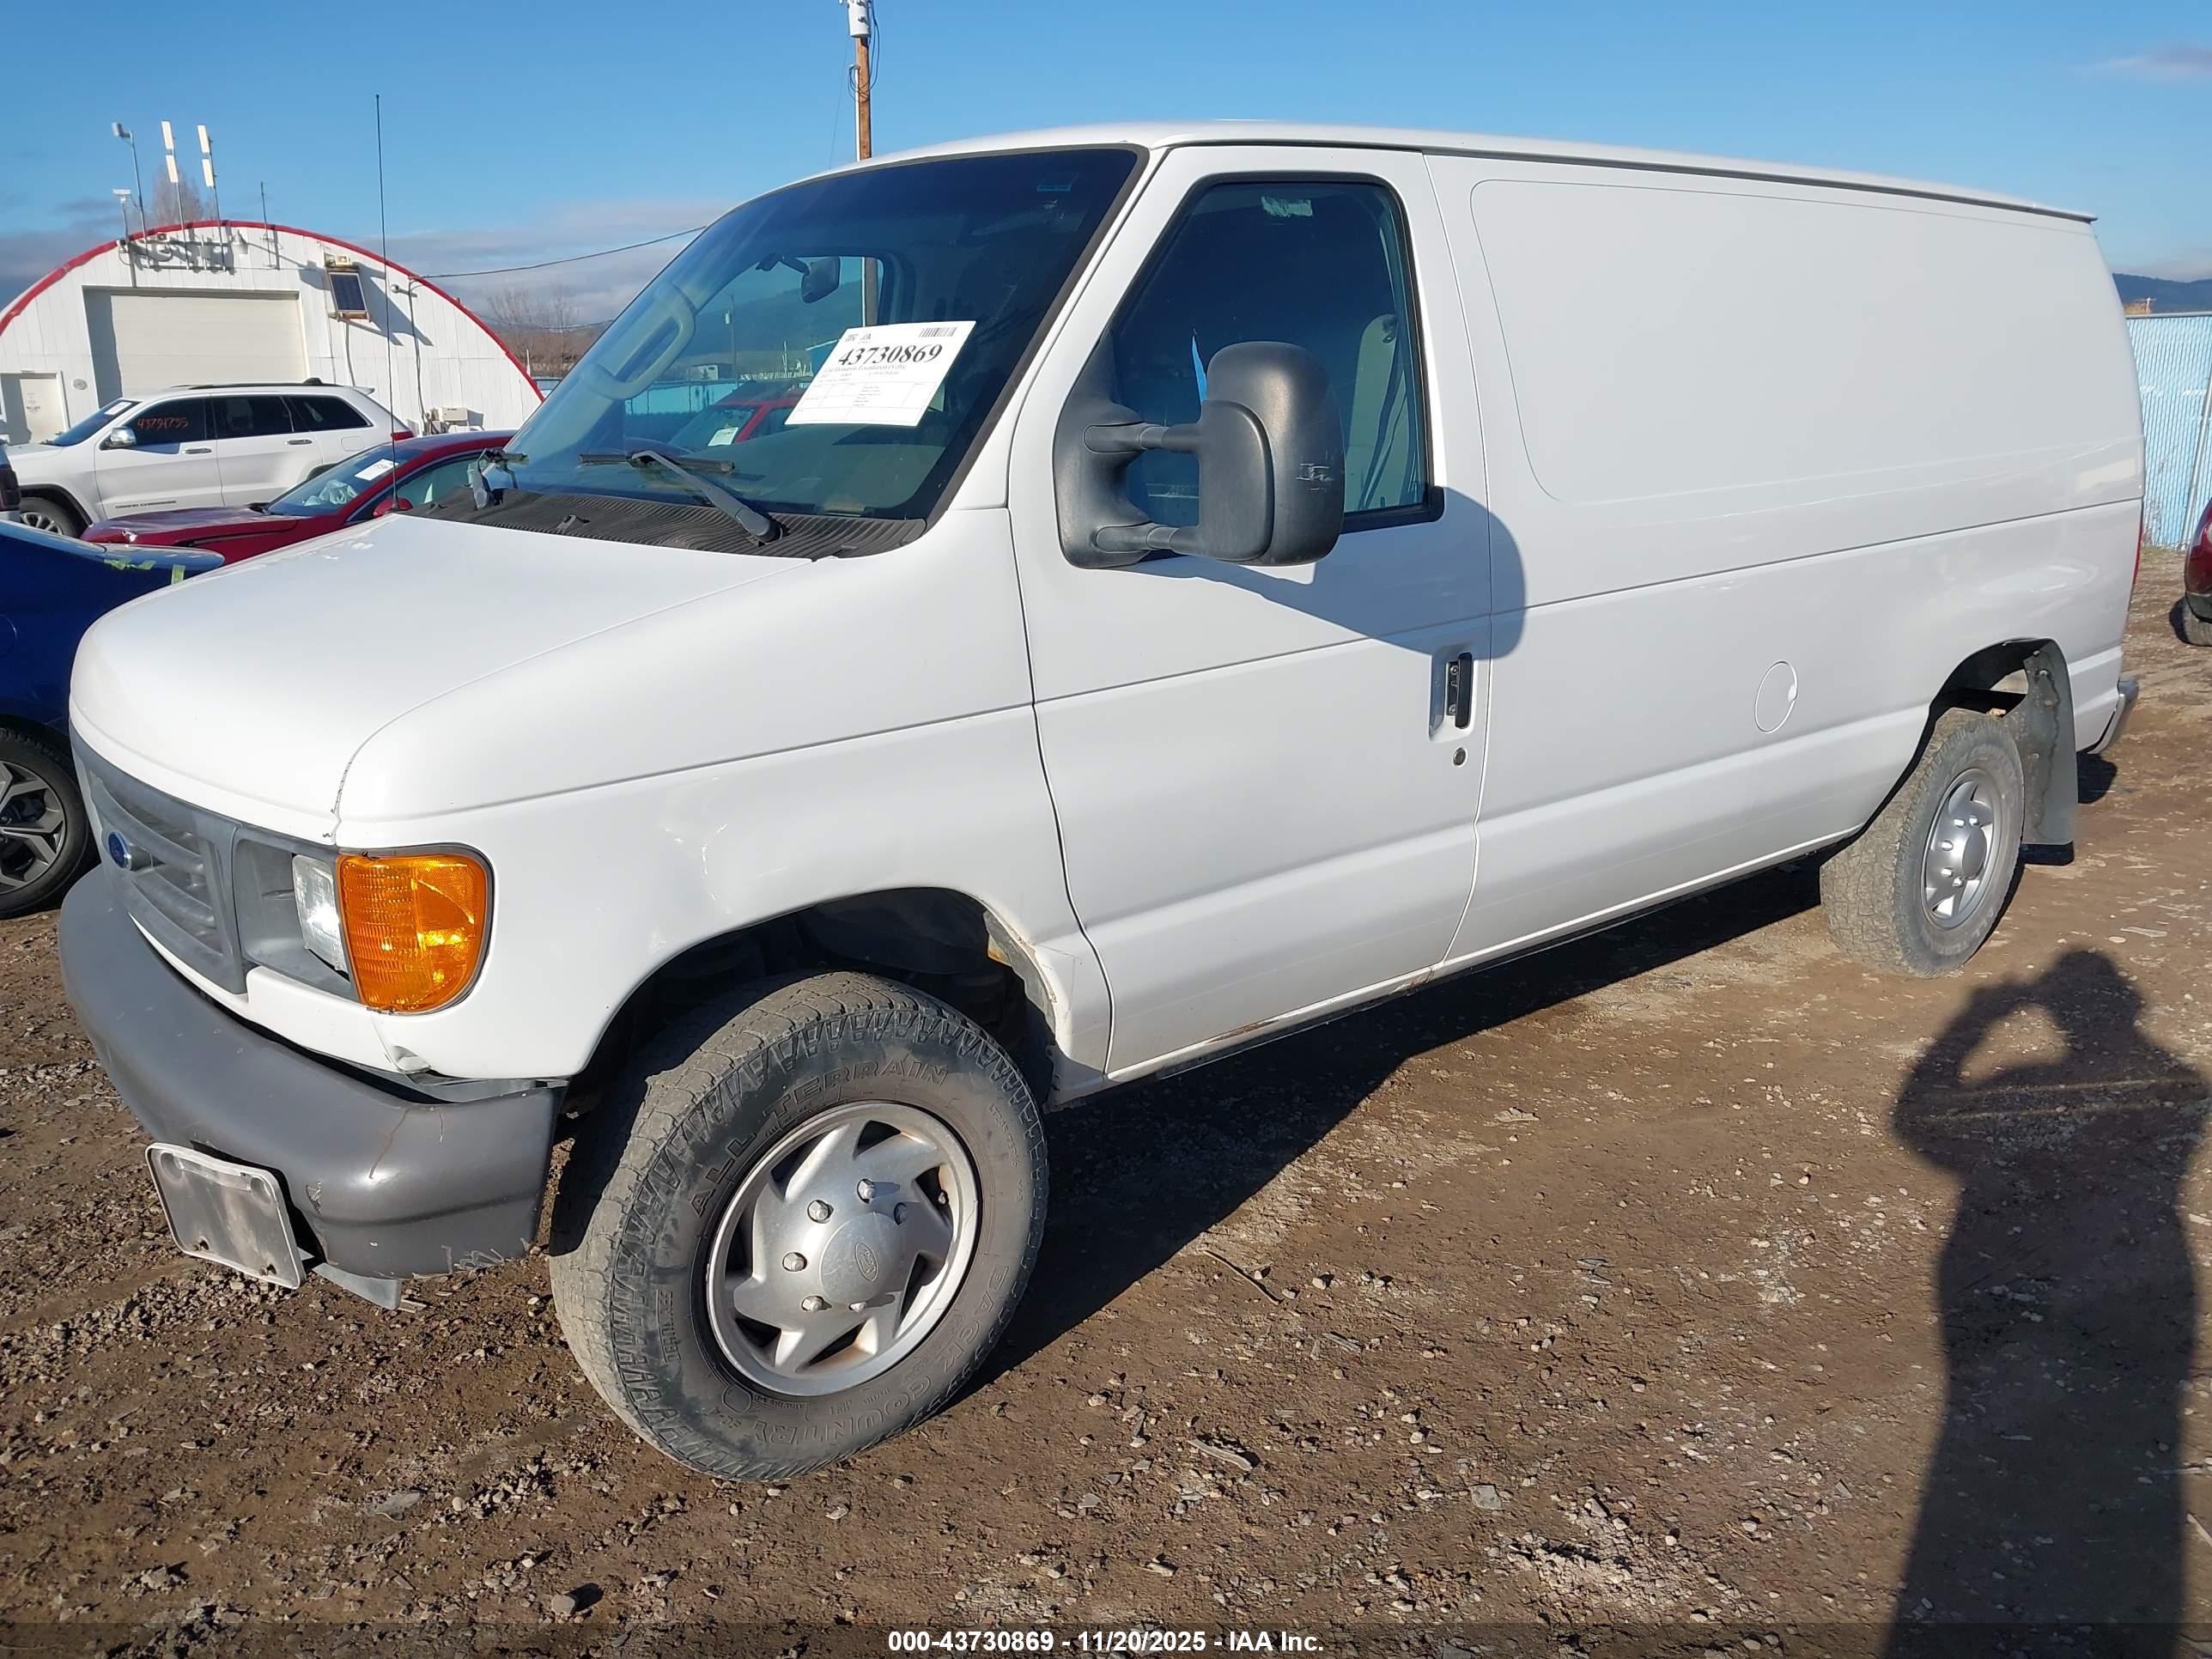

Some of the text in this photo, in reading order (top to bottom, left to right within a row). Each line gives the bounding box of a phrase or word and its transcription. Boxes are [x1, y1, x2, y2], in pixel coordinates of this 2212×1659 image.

[839, 343, 943, 366] 43730869
[690, 1059, 949, 1217] ALL TERRAIN
[753, 1376, 932, 1444] COUNTRY
